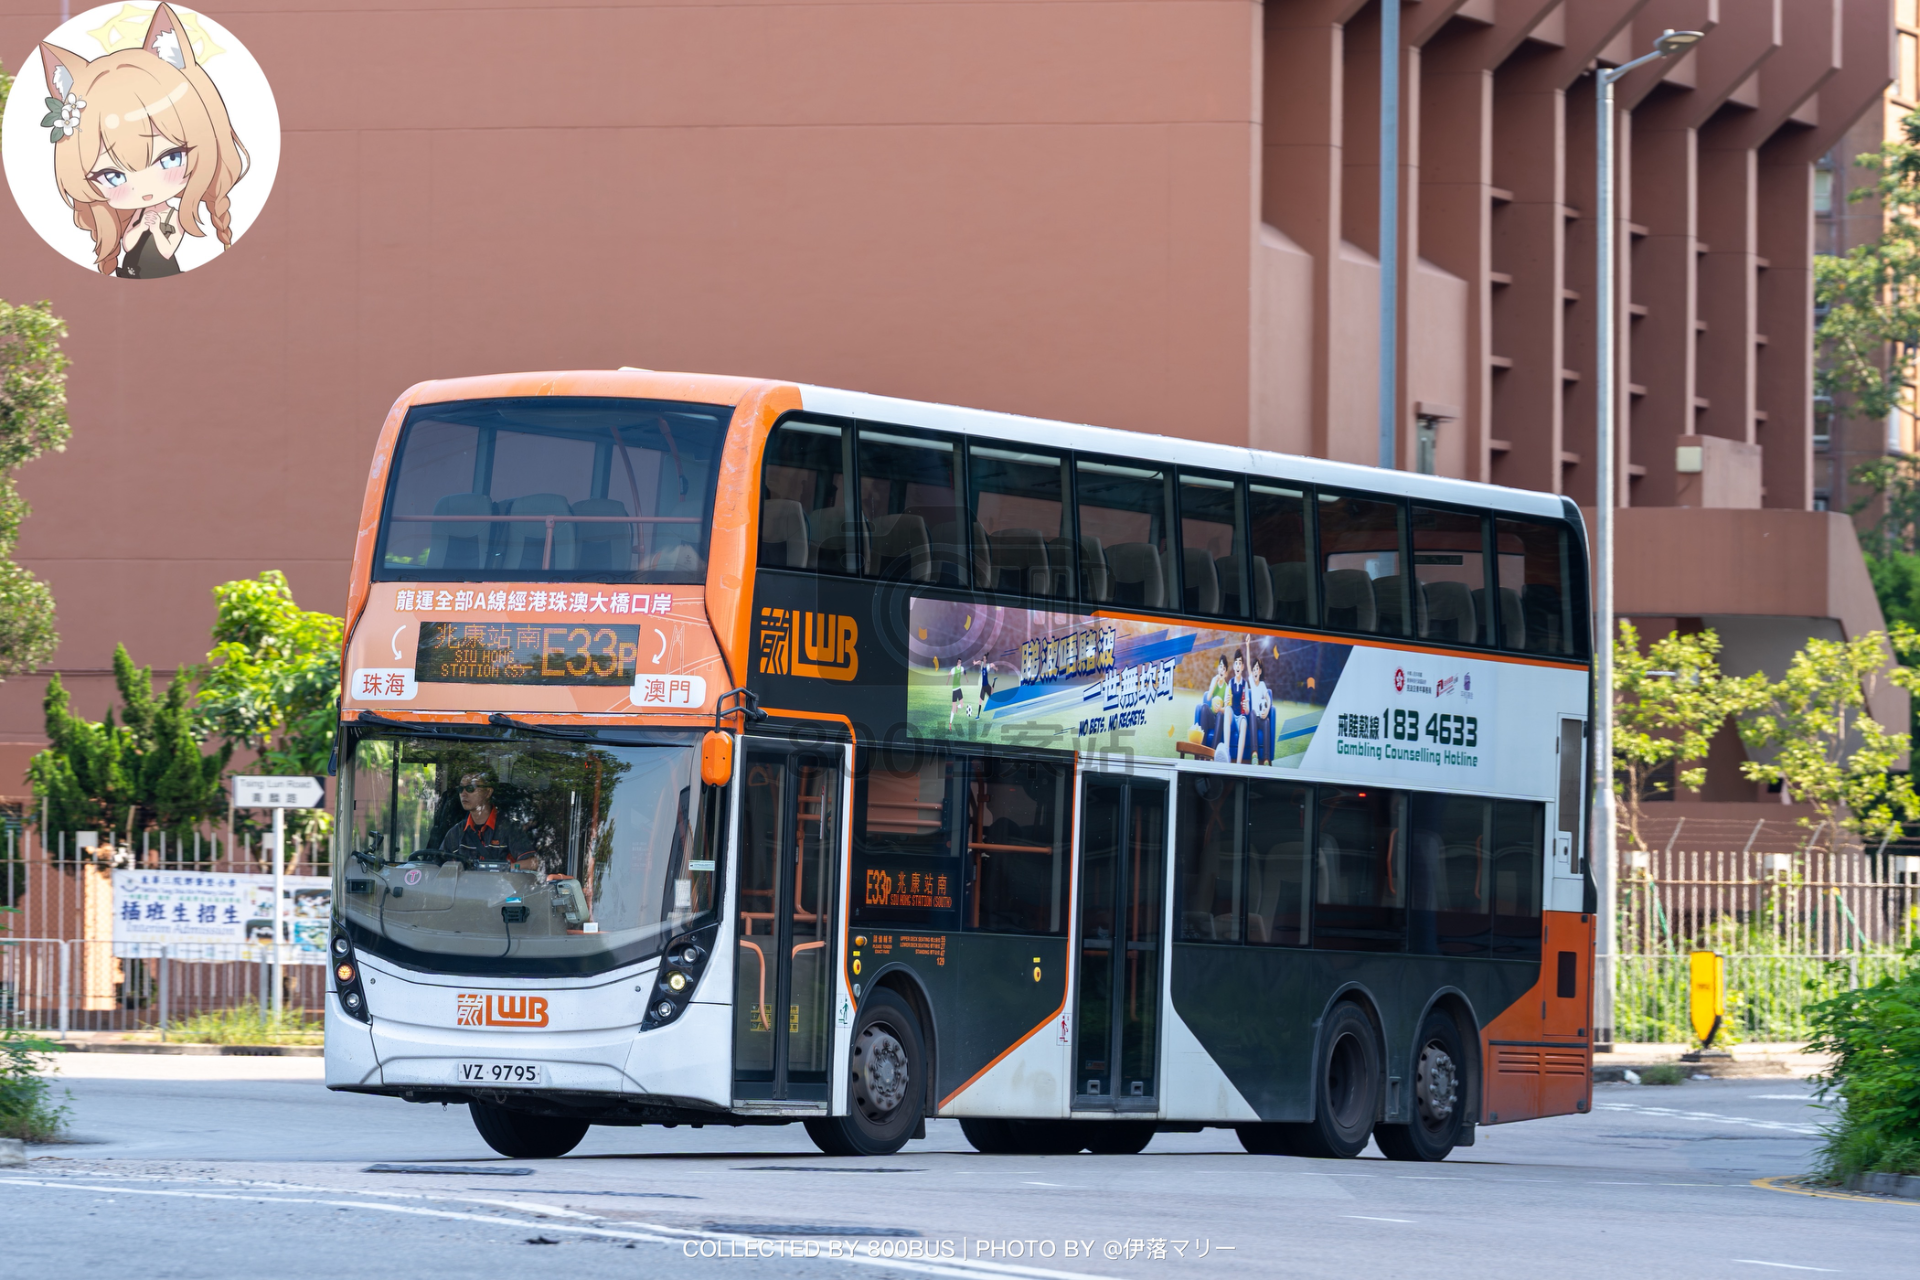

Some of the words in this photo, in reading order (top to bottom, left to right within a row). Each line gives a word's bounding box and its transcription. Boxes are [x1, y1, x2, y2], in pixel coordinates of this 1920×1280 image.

[395, 589, 673, 615] 龍運全部A線經港珠澳大橋口岸
[435, 623, 542, 650] 兆康站南
[790, 610, 859, 682] LWB
[455, 650, 477, 663] SIU
[483, 650, 515, 663] HONG
[541, 627, 637, 677] E33P
[1021, 626, 1117, 687] 睇波唔賭波
[362, 672, 406, 697] 珠海
[441, 664, 500, 678] STATION
[1083, 657, 1176, 711] 一世無坎坷
[643, 678, 691, 704] 澳門
[1078, 719, 1089, 737] NO
[1089, 717, 1107, 736] BETS.
[1108, 715, 1118, 731] NO
[1118, 709, 1148, 731] REGRETS.
[1338, 713, 1380, 740] 戒賭熱線
[1382, 708, 1419, 742] 183
[1425, 713, 1478, 748] 4633
[1337, 739, 1382, 760] Gambling
[1385, 743, 1441, 766] Counselling
[1443, 749, 1479, 767] Hotline
[866, 869, 892, 905] E33P
[896, 871, 947, 895] 兆康站南
[485, 995, 549, 1028] LWB
[463, 1064, 484, 1080] VZ
[492, 1065, 536, 1081] 9795
